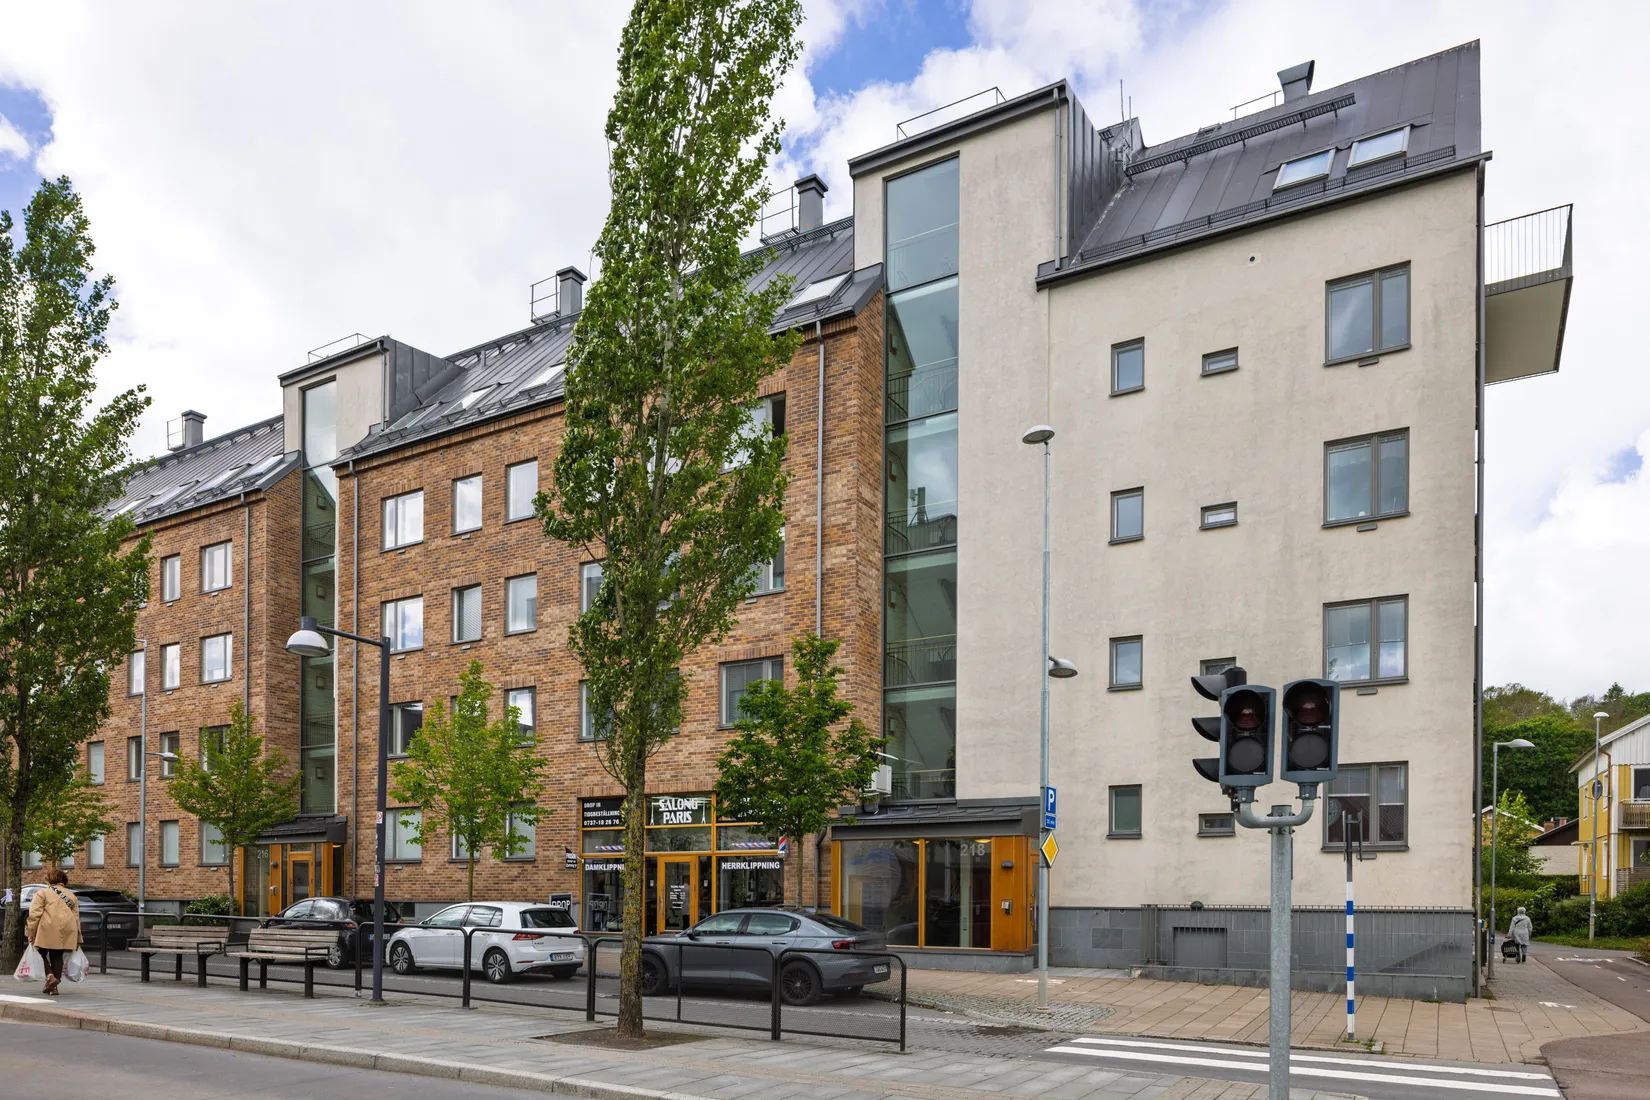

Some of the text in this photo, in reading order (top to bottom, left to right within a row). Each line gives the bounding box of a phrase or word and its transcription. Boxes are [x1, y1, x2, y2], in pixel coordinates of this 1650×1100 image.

[659, 799, 697, 811] SALONG
[1048, 789, 1055, 811] P
[663, 811, 692, 824] PARIS
[257, 849, 269, 859] 216
[960, 843, 985, 856] 218
